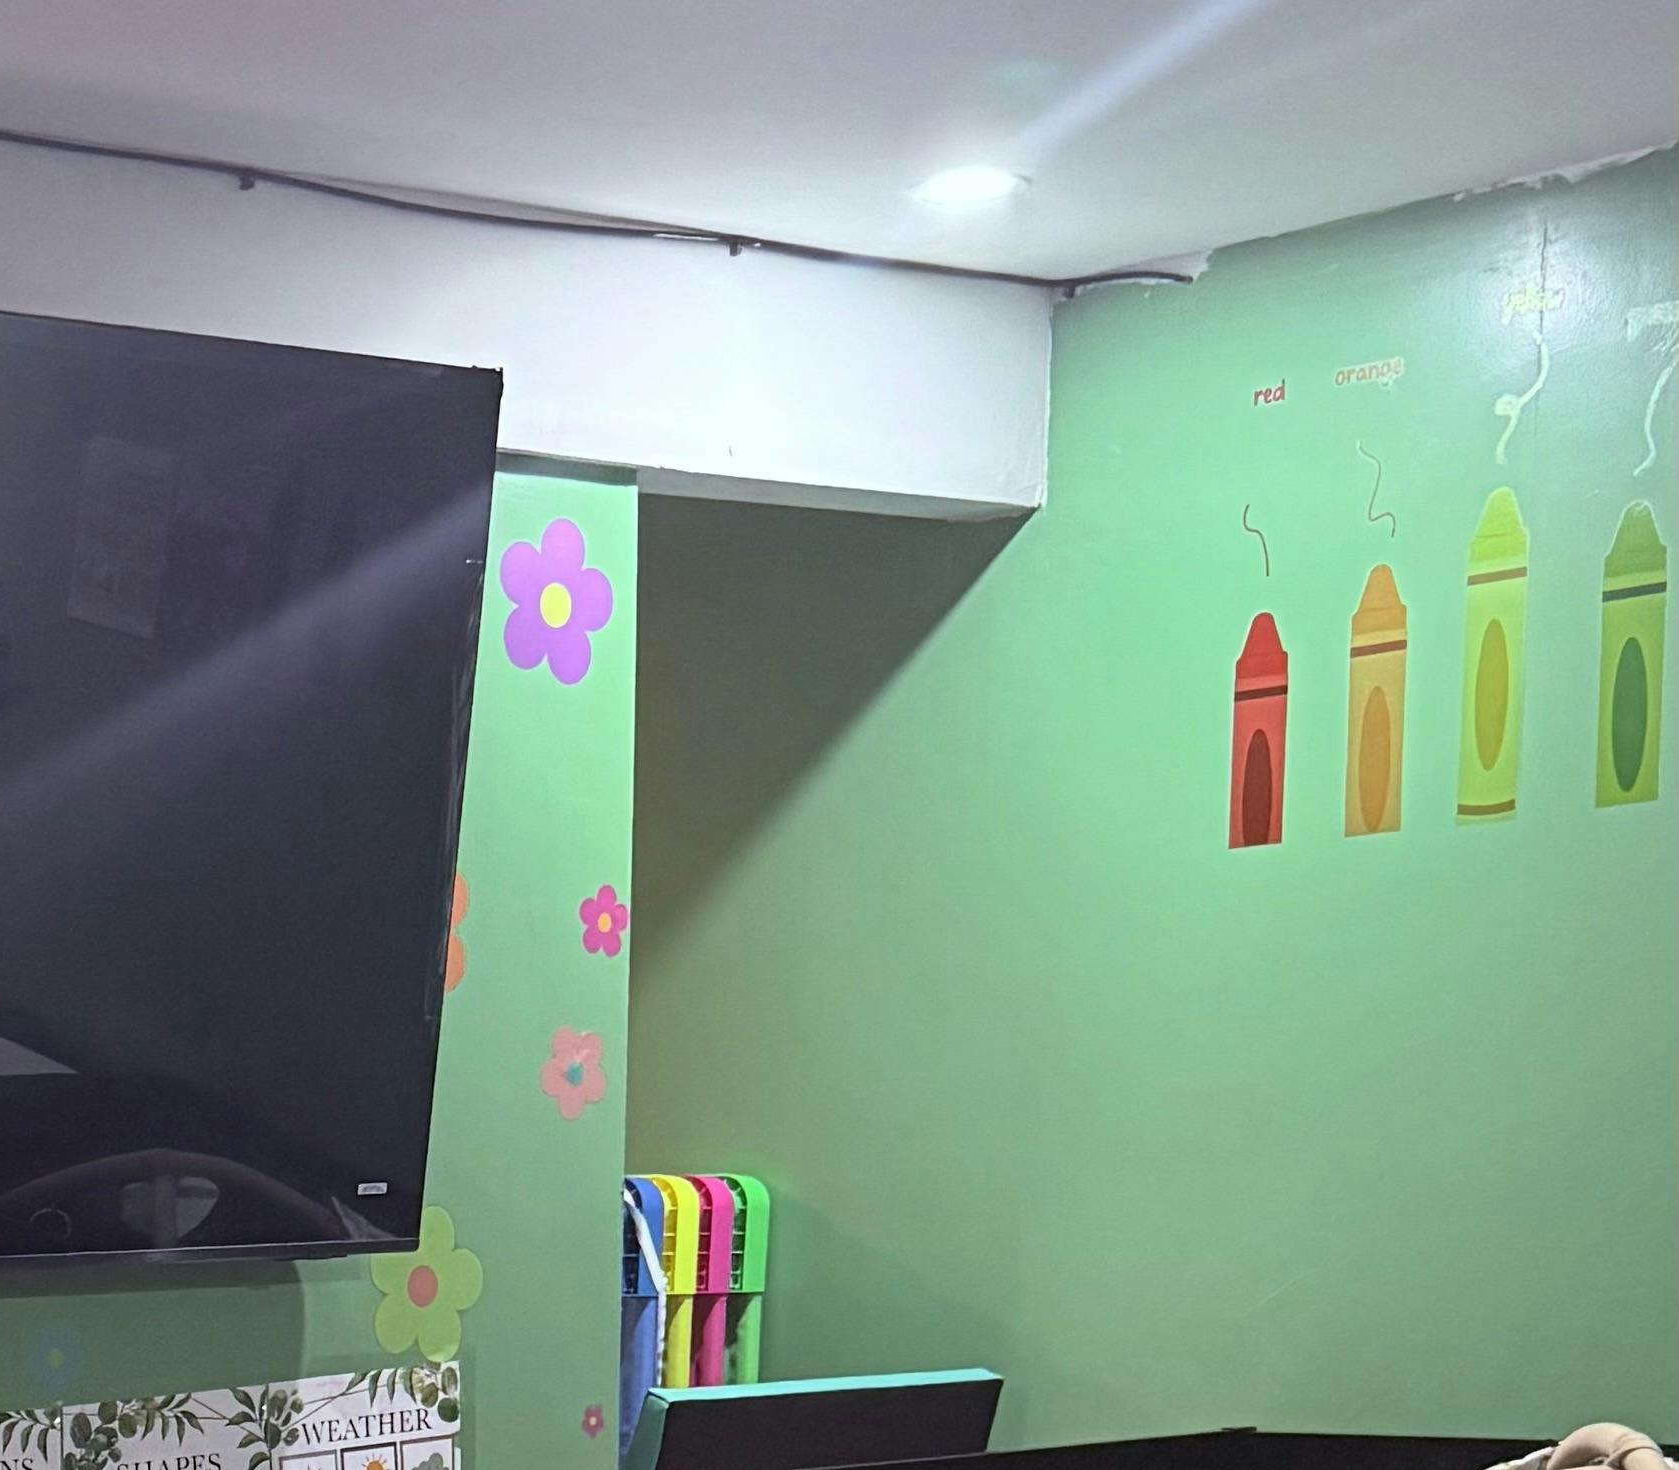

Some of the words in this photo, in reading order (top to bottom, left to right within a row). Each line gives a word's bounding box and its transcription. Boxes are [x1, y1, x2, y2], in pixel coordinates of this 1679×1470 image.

[1334, 357, 1404, 387] orange
[1253, 378, 1286, 407] red
[301, 1408, 433, 1446] WEATHER
